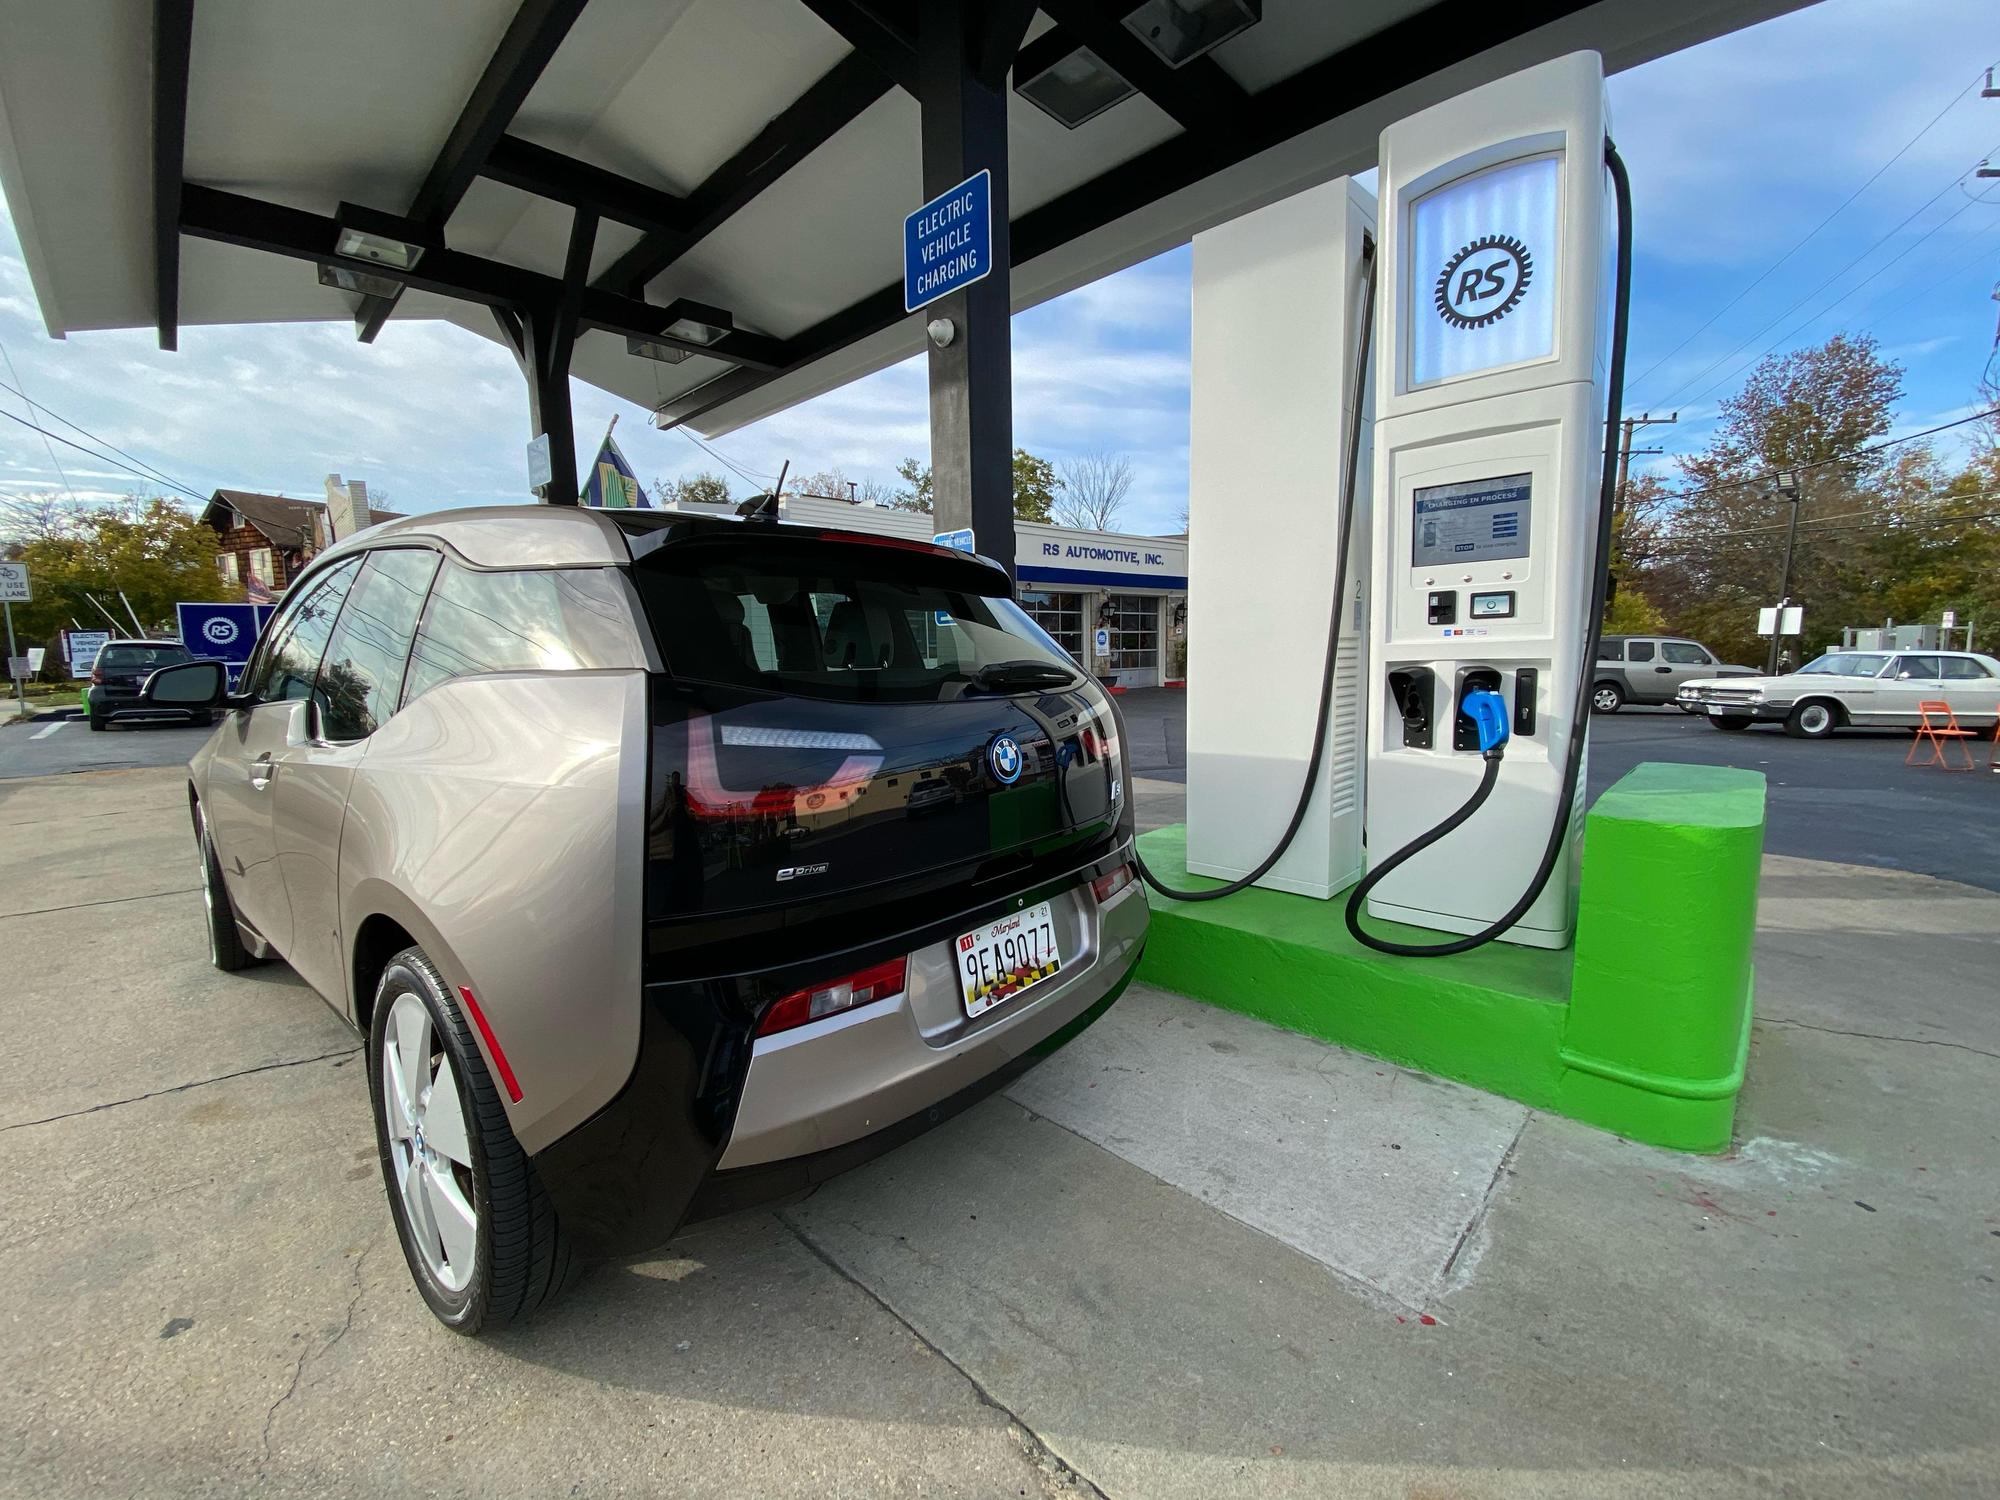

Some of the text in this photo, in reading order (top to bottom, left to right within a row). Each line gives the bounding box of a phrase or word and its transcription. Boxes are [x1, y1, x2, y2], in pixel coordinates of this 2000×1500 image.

[918, 192, 973, 240] ELECTRIC
[921, 222, 972, 264] VEHICLE
[917, 249, 977, 295] CHARGING
[1455, 259, 1510, 306] RS
[1428, 498, 1468, 509] CHARGING
[1481, 491, 1518, 502] PROCESS
[1043, 543, 1164, 566] RS AUTOMOTIVE, INC.
[1456, 544, 1474, 552] STOP
[1356, 580, 1362, 599] 2
[211, 625, 231, 636] RS
[995, 740, 1017, 754] BMW
[991, 917, 1021, 938] Maryland
[966, 923, 1050, 992] 9EA9077
